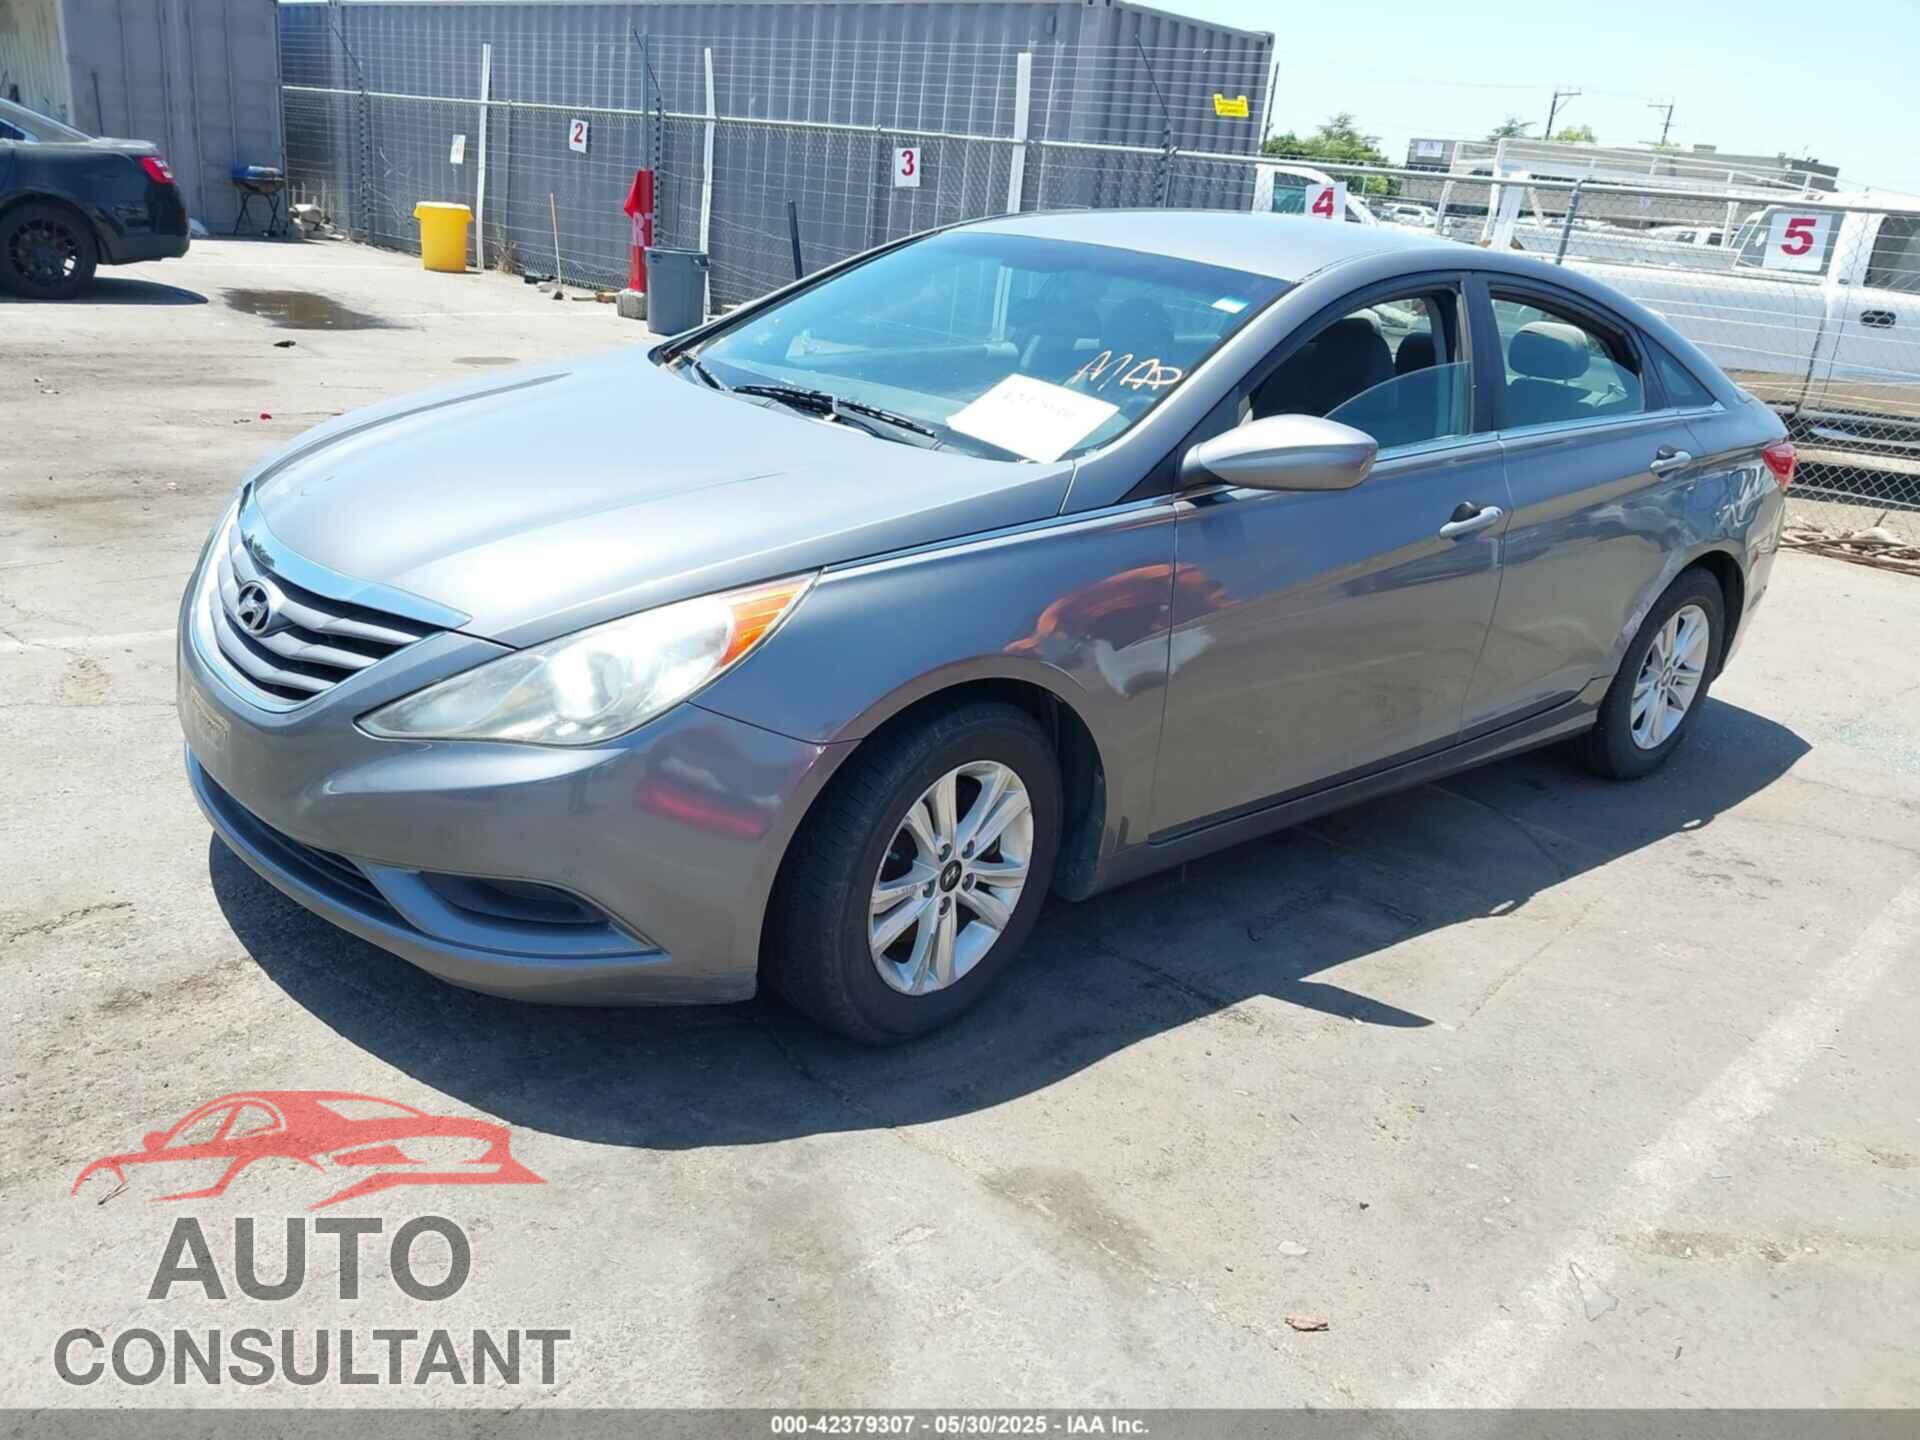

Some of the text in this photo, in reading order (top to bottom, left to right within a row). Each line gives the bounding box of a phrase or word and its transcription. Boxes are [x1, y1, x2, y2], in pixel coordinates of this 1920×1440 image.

[574, 122, 584, 144] 2
[901, 150, 915, 176] 3
[1311, 187, 1335, 219] 4
[1780, 218, 1817, 256] 5
